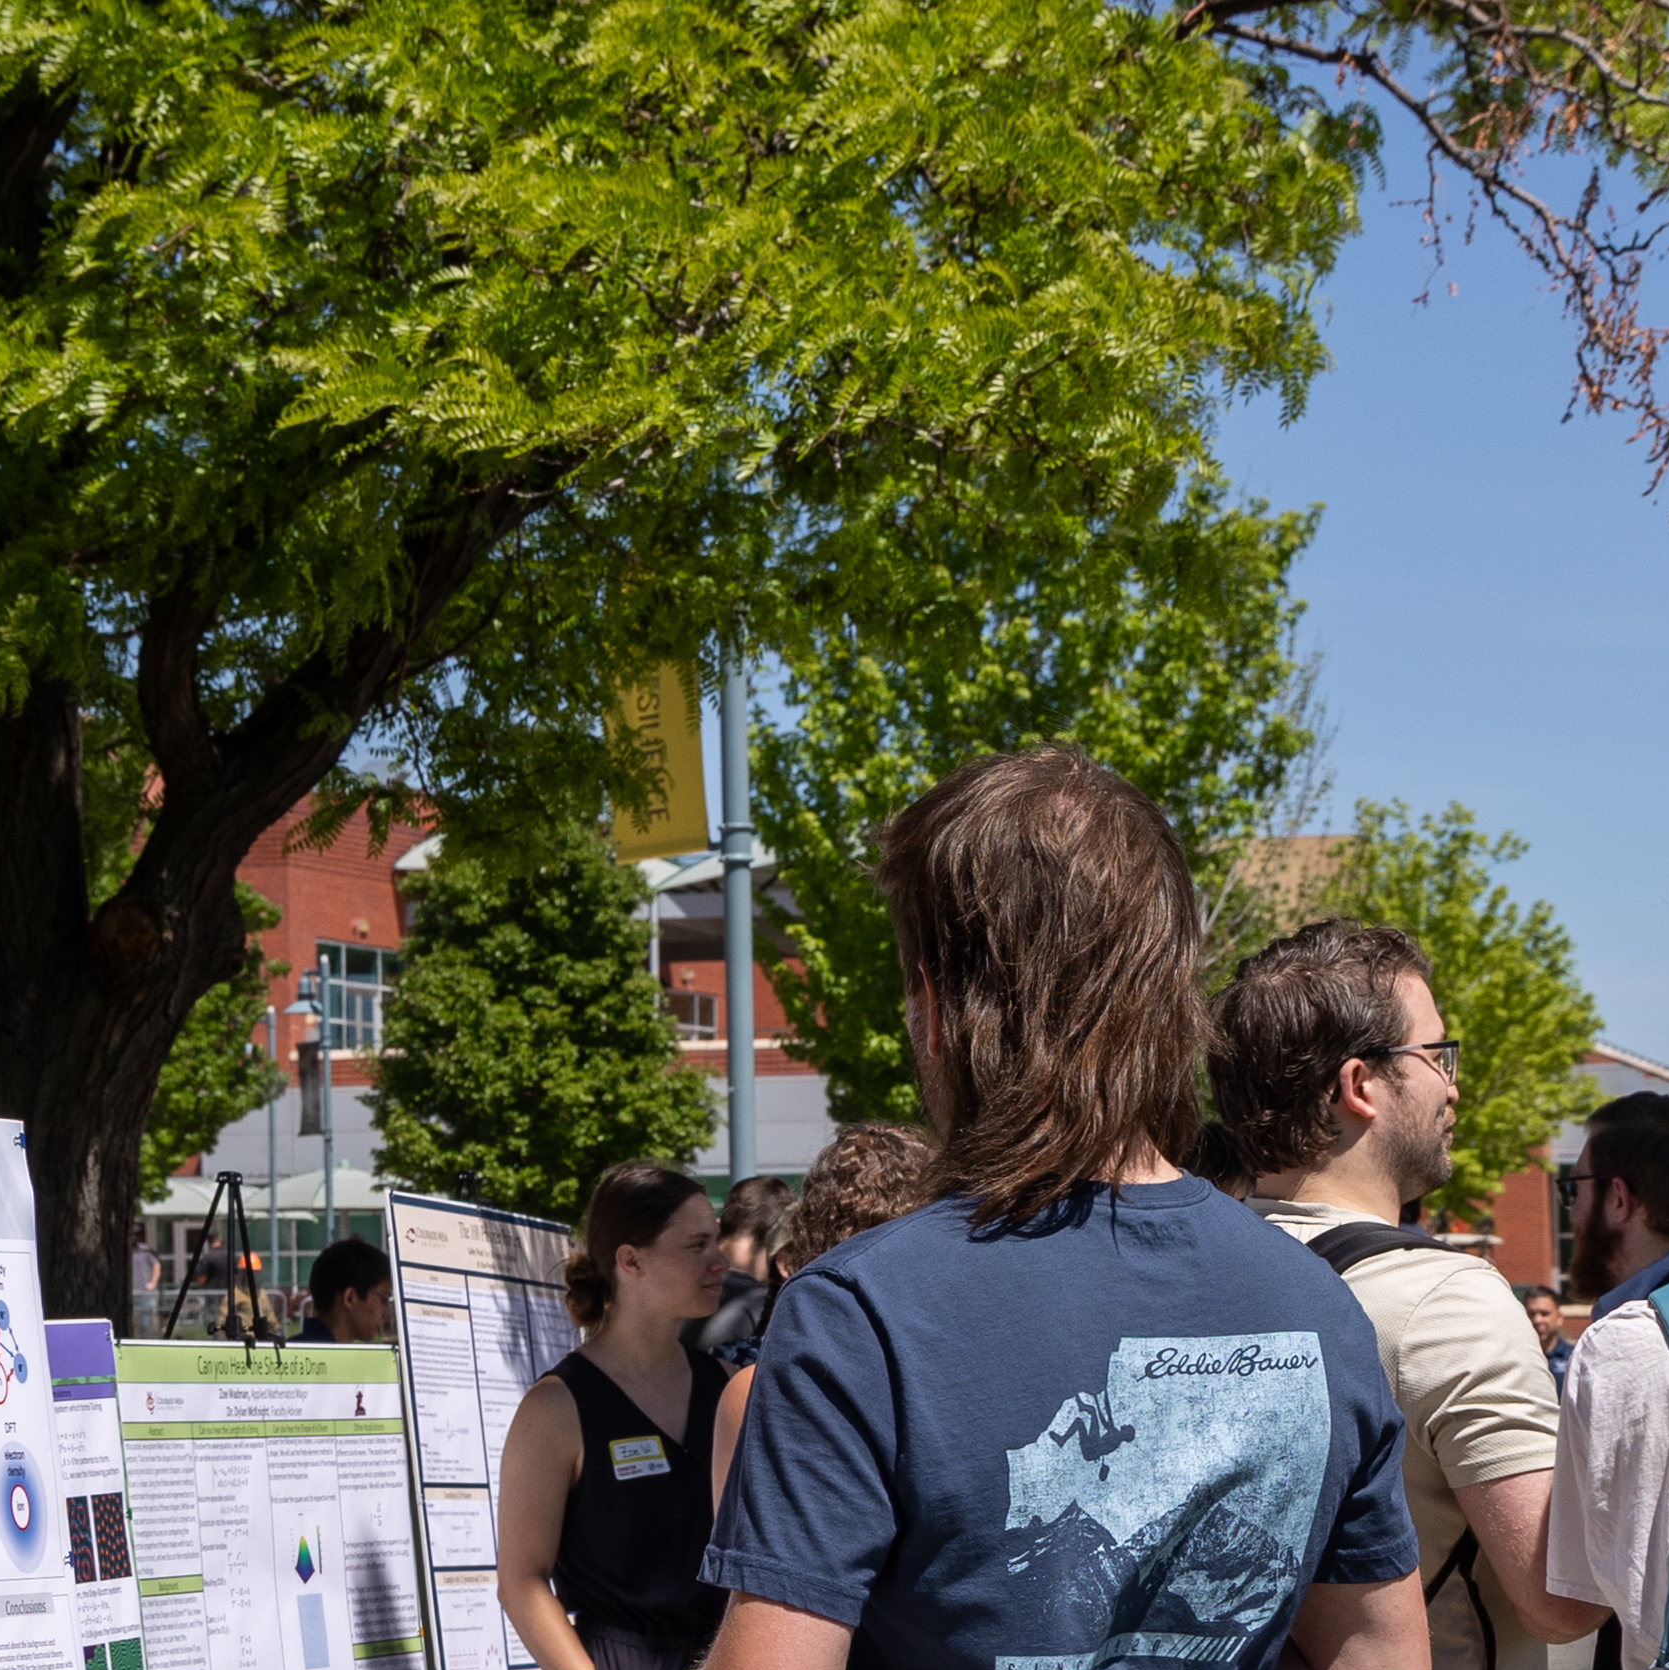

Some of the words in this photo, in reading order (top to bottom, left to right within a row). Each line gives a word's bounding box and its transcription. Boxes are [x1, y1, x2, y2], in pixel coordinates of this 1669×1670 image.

[197, 1356, 214, 1376] Can
[213, 1360, 229, 1381] you
[230, 1357, 250, 1376] Hear
[250, 1357, 264, 1376] the
[264, 1357, 290, 1380] Shape
[289, 1357, 300, 1375] of
[299, 1361, 305, 1375] a
[305, 1357, 327, 1376] Drum
[1136, 1346, 1223, 1383] Eddie
[1221, 1344, 1319, 1378] Bauer
[4, 1422, 17, 1433] DFT
[4, 1450, 26, 1461] electron
[7, 1465, 26, 1479] density
[16, 1502, 26, 1512] ion
[4, 1599, 47, 1616] Conclusions
